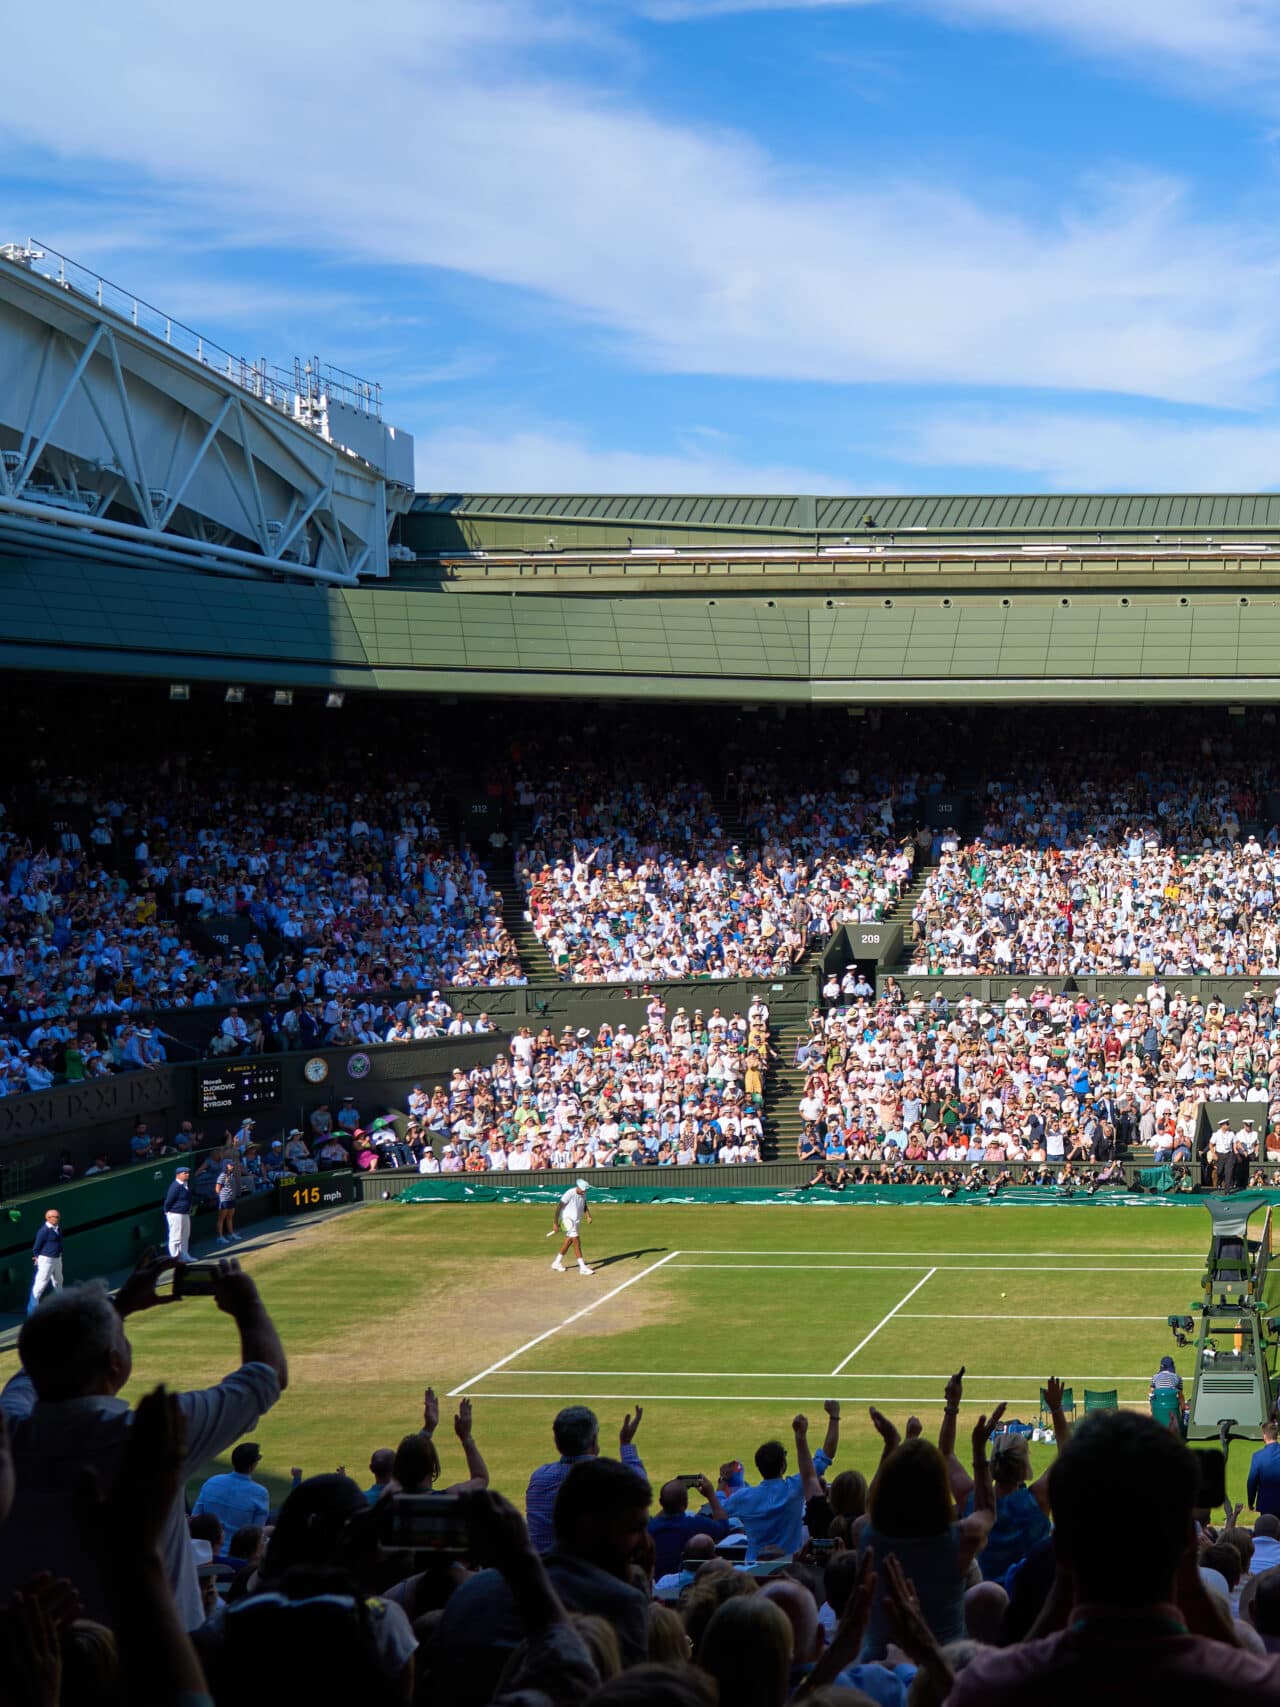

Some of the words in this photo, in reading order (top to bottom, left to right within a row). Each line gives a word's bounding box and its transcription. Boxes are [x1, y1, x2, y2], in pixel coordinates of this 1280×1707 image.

[472, 804, 488, 813] 312
[861, 934, 880, 944] 209
[203, 1083, 236, 1092] DJOKOVIC
[280, 1177, 297, 1187] IBM
[293, 1187, 321, 1206] 115
[323, 1190, 342, 1201] mph
